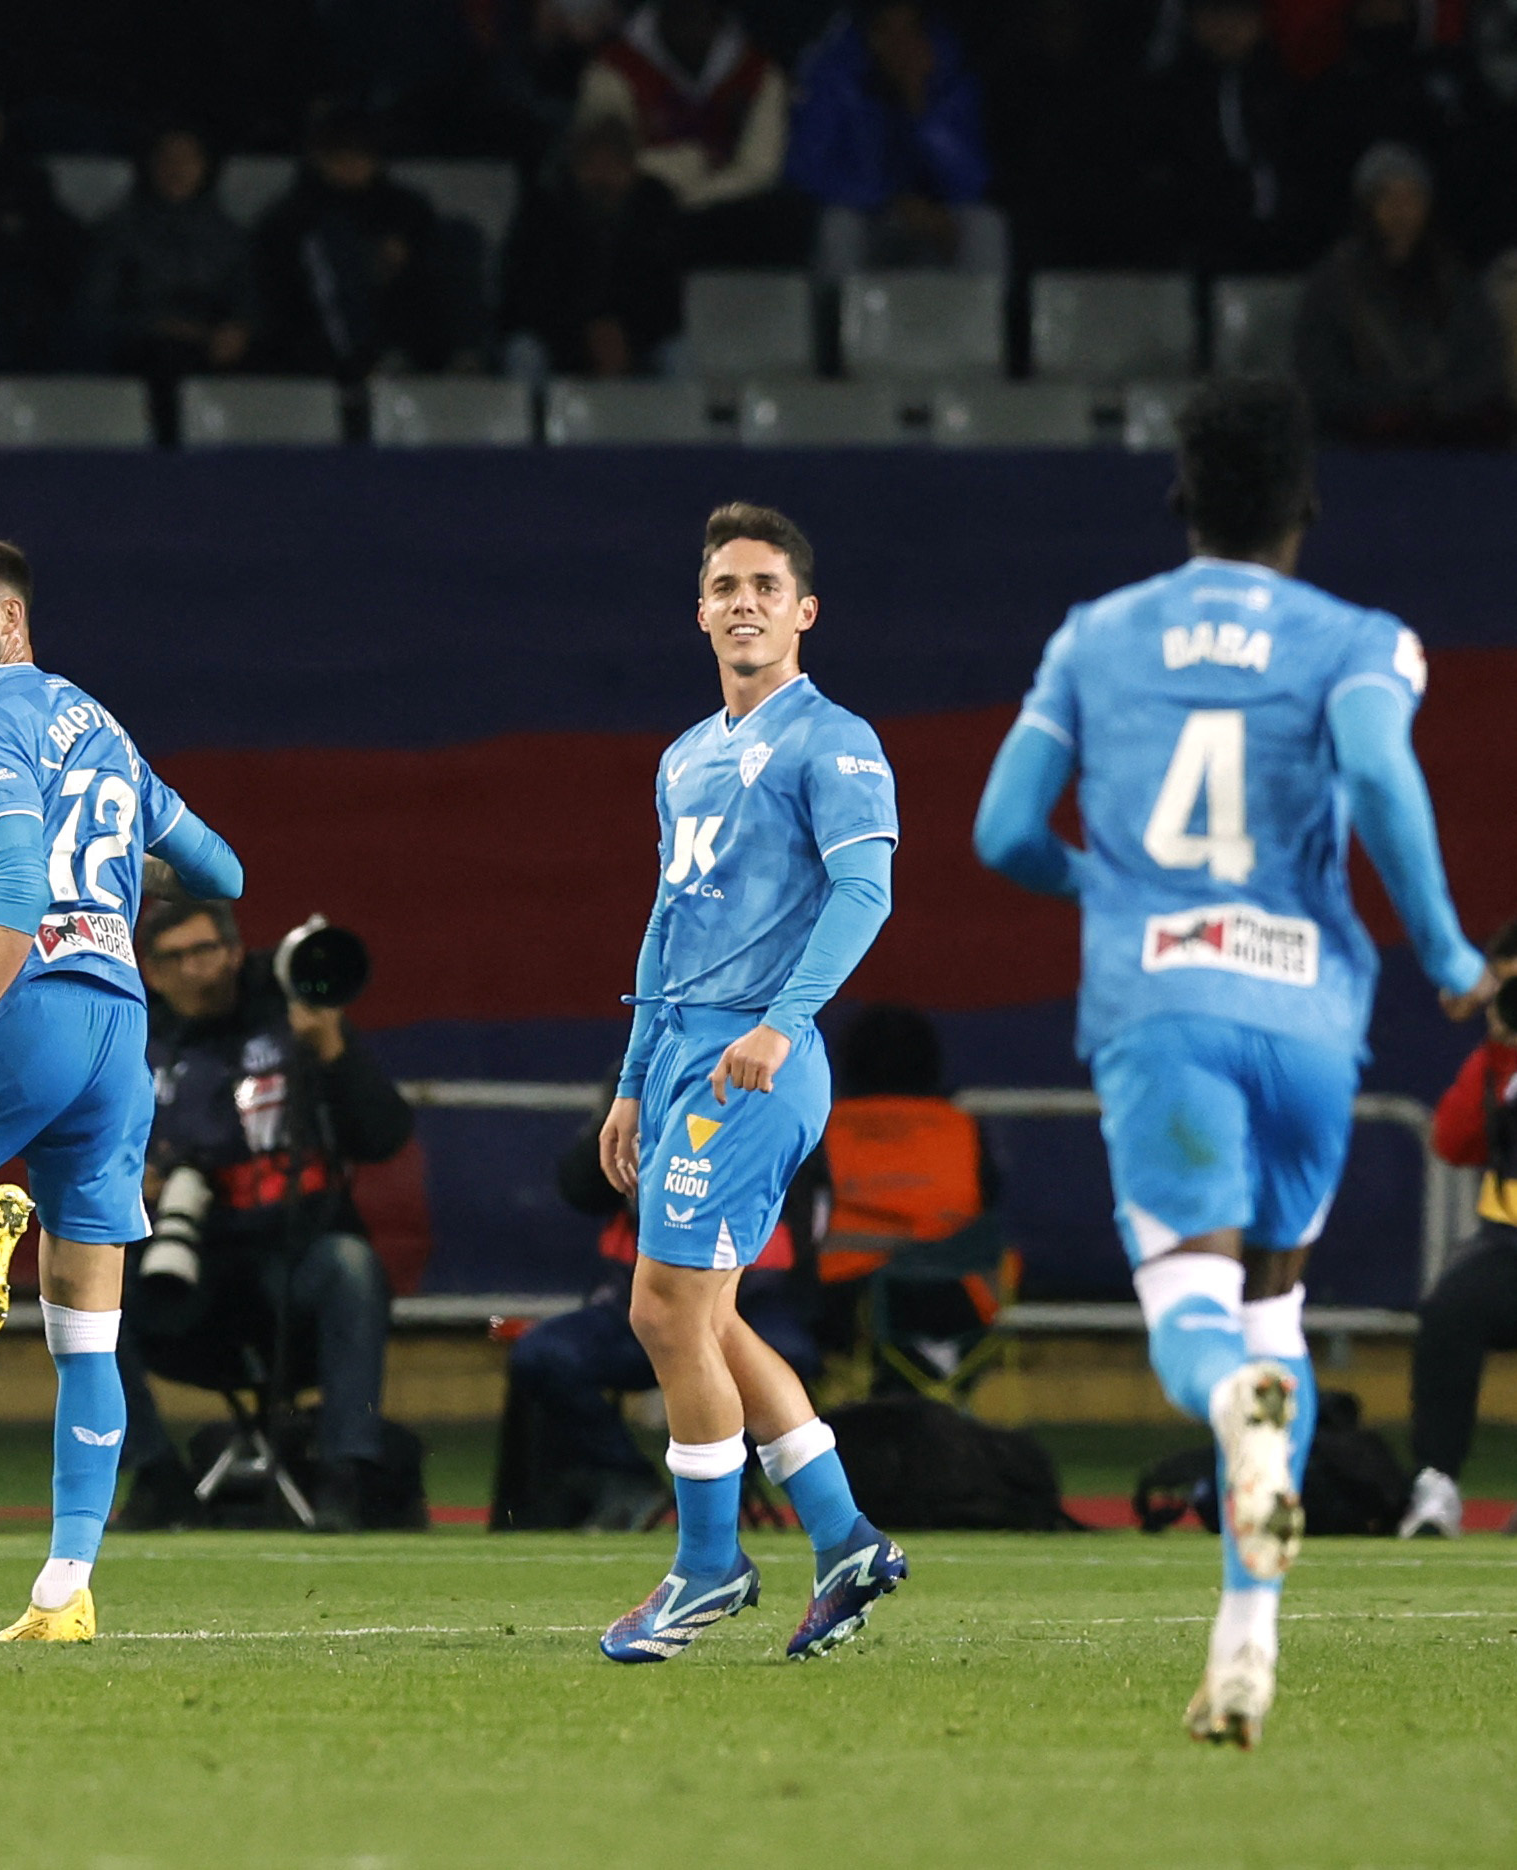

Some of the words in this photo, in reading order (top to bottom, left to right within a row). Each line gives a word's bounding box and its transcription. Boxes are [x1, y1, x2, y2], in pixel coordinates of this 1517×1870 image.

[1163, 621, 1272, 673] BABA
[1143, 711, 1256, 886] 4
[49, 768, 137, 910] 12
[664, 816, 725, 885] JK
[700, 883, 725, 900] Co.
[663, 1171, 710, 1198] KUDU
